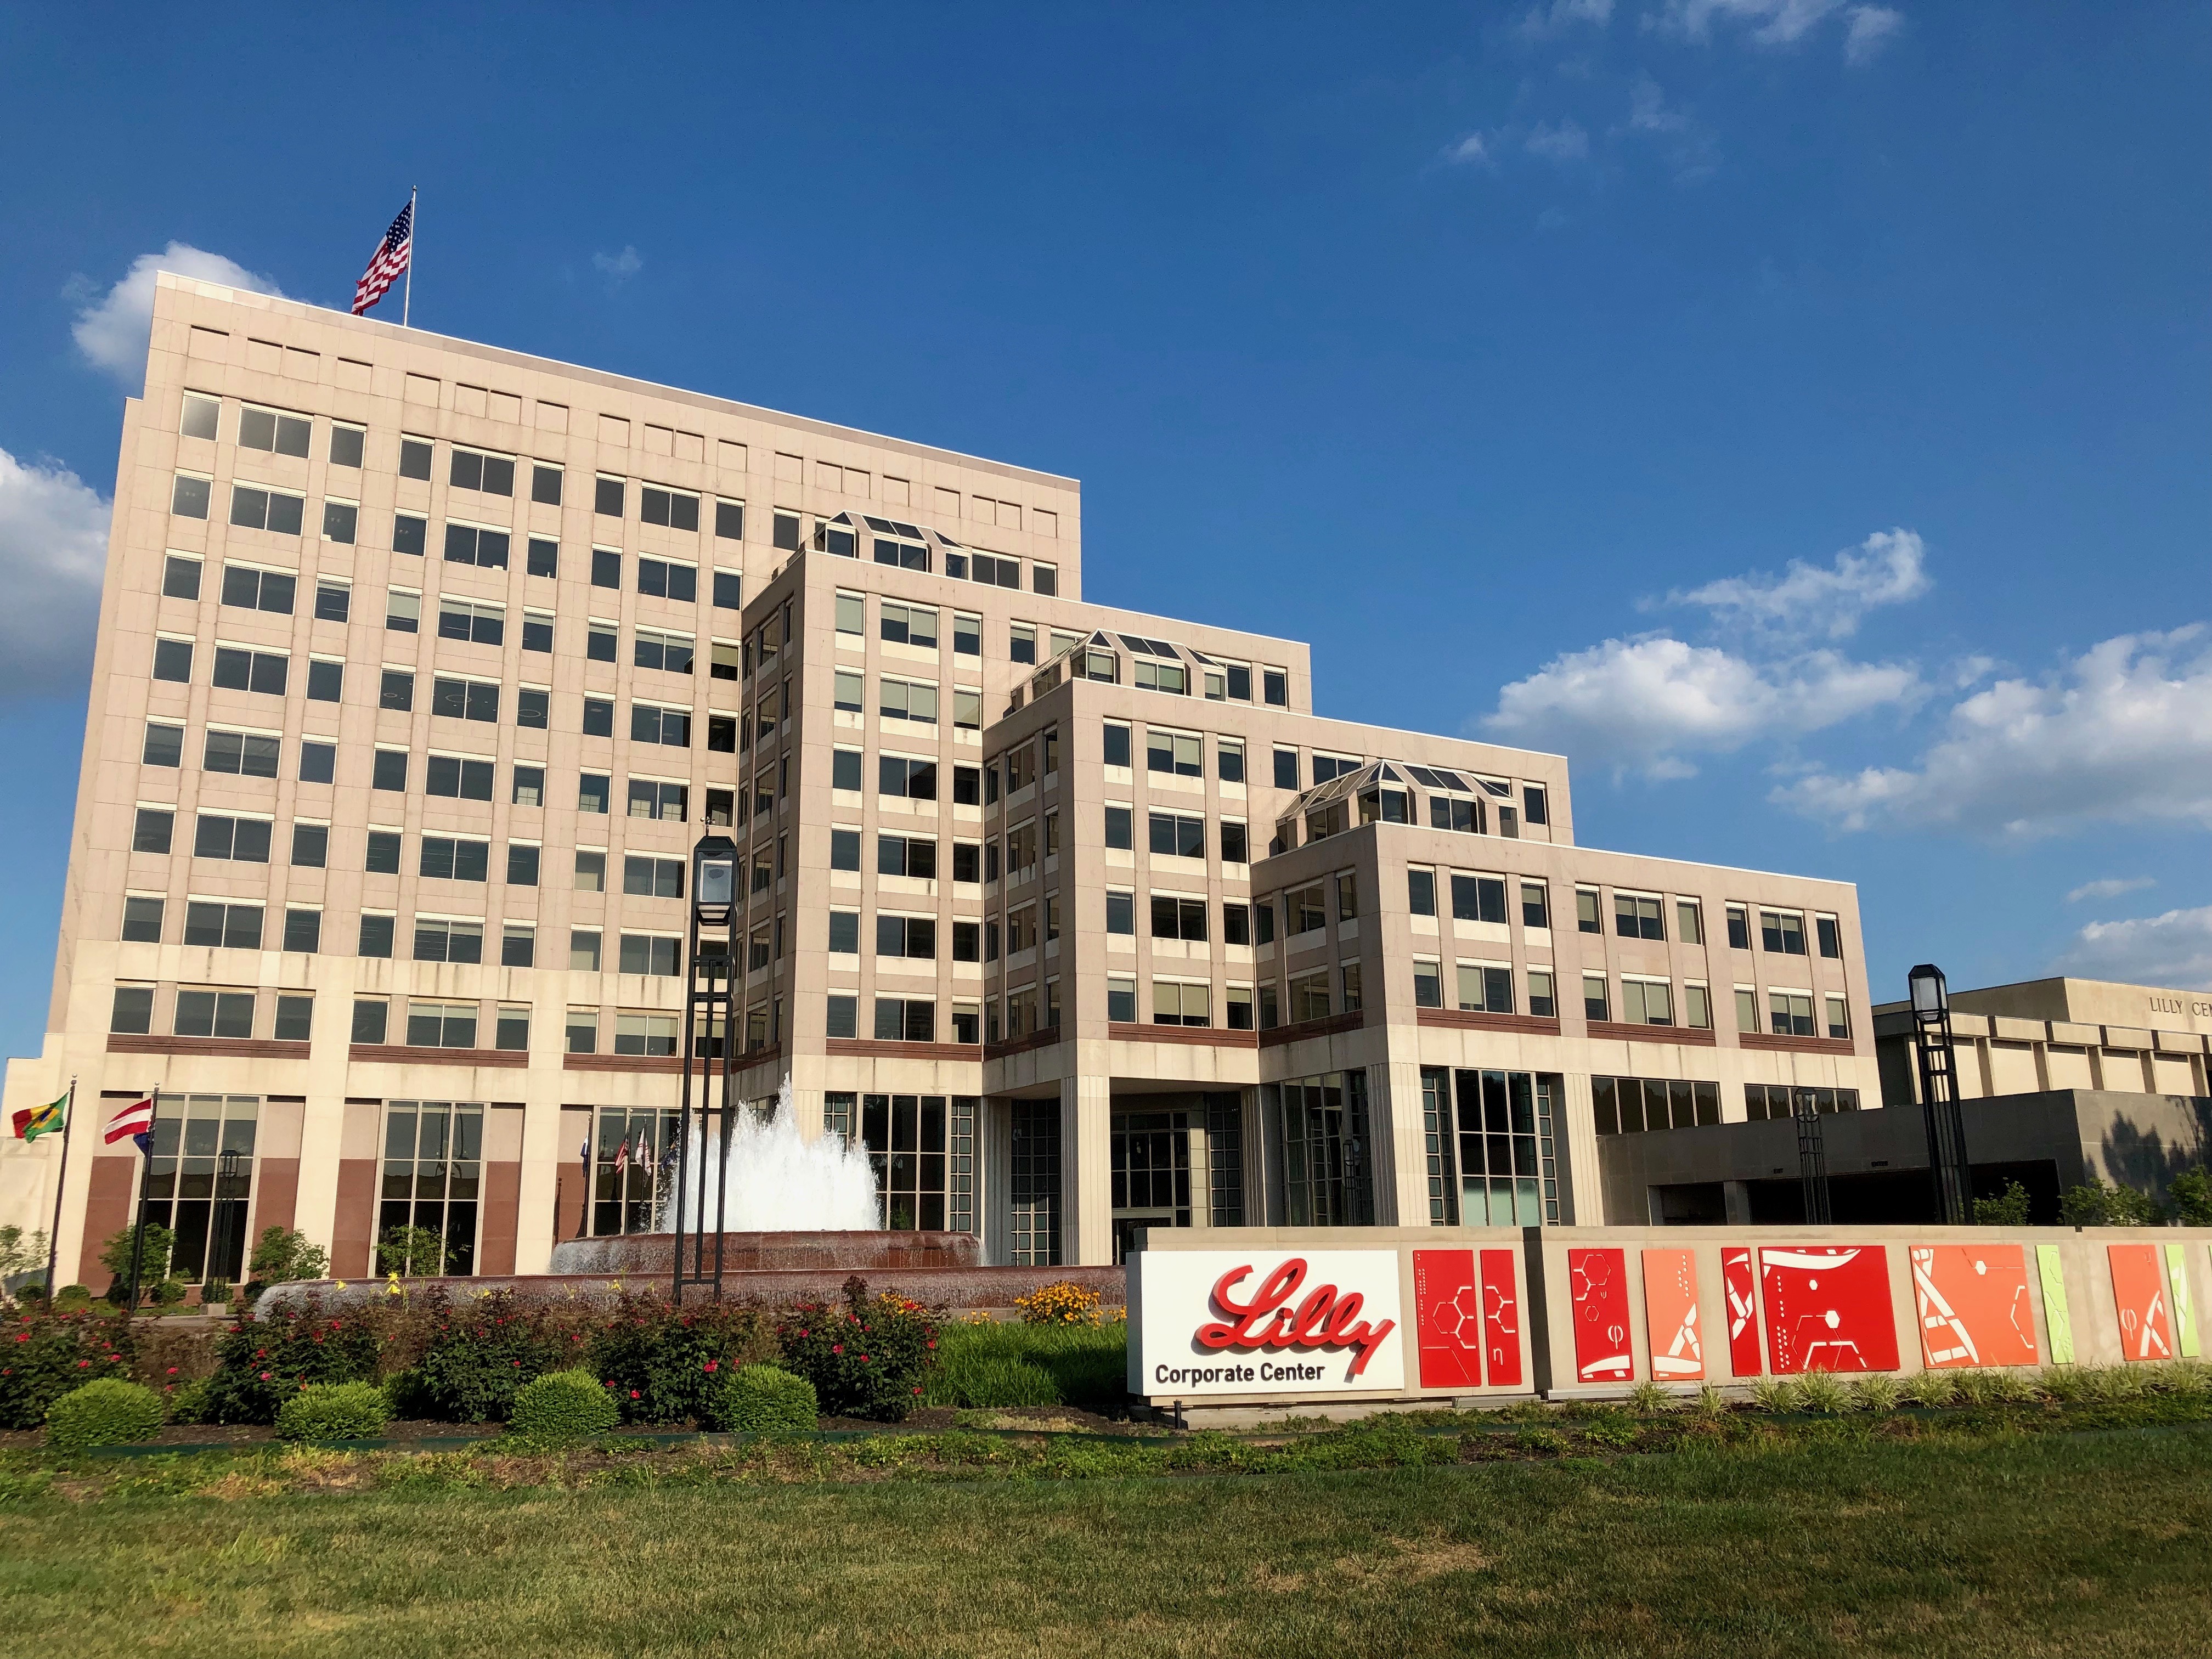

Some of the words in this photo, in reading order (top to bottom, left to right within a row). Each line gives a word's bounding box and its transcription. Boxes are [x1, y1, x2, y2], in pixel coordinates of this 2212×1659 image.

[2149, 997, 2182, 1014] LILLY
[1196, 1257, 1396, 1375] Lilly
[1155, 1364, 1255, 1388] Corporate
[1261, 1362, 1326, 1381] Center
